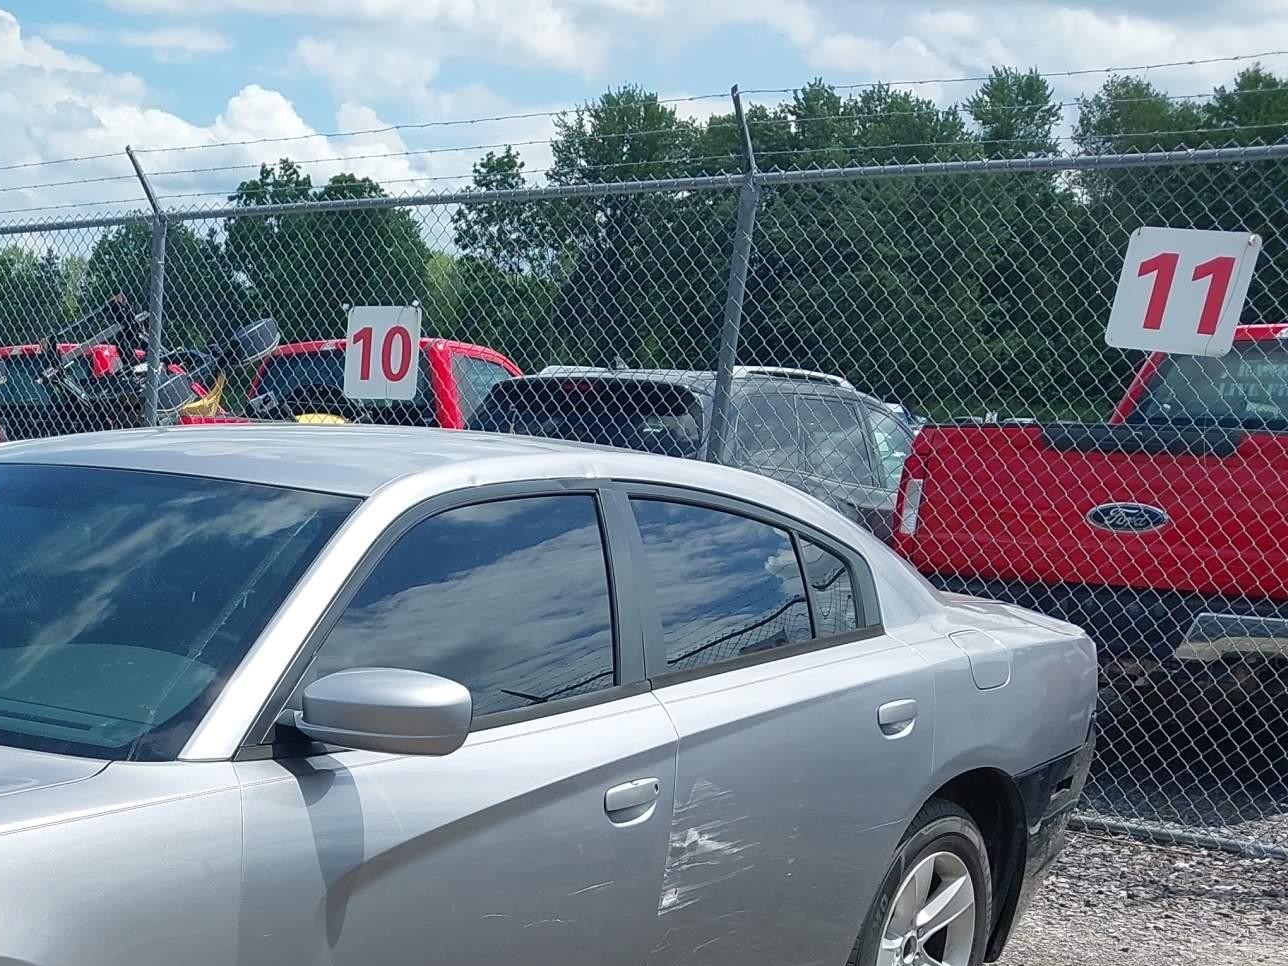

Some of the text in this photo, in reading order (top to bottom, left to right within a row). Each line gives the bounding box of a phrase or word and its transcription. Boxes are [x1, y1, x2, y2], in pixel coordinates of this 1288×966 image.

[1137, 252, 1236, 336] 11
[352, 325, 412, 382] 10
[1104, 507, 1150, 530] Ford
